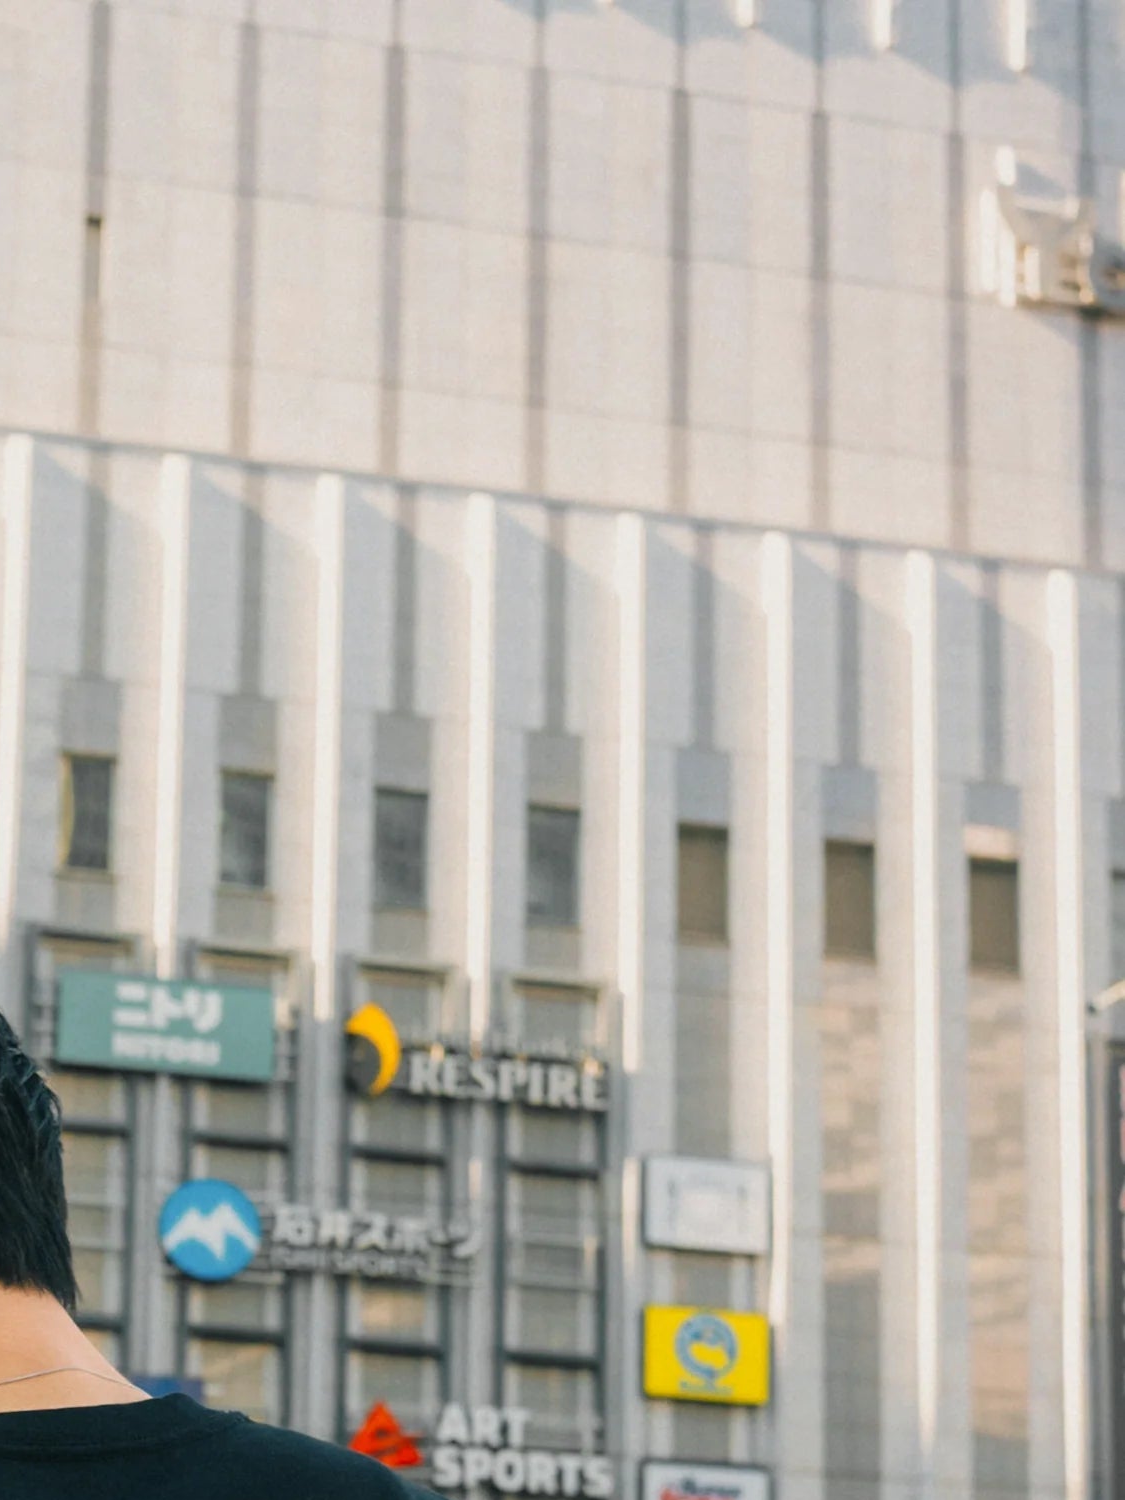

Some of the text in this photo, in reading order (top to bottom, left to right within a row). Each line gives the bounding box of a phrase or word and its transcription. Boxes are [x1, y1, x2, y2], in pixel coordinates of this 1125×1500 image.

[409, 1050, 606, 1110] RESPIRE
[437, 1400, 529, 1447] ART
[432, 1446, 615, 1498] SPORTS
